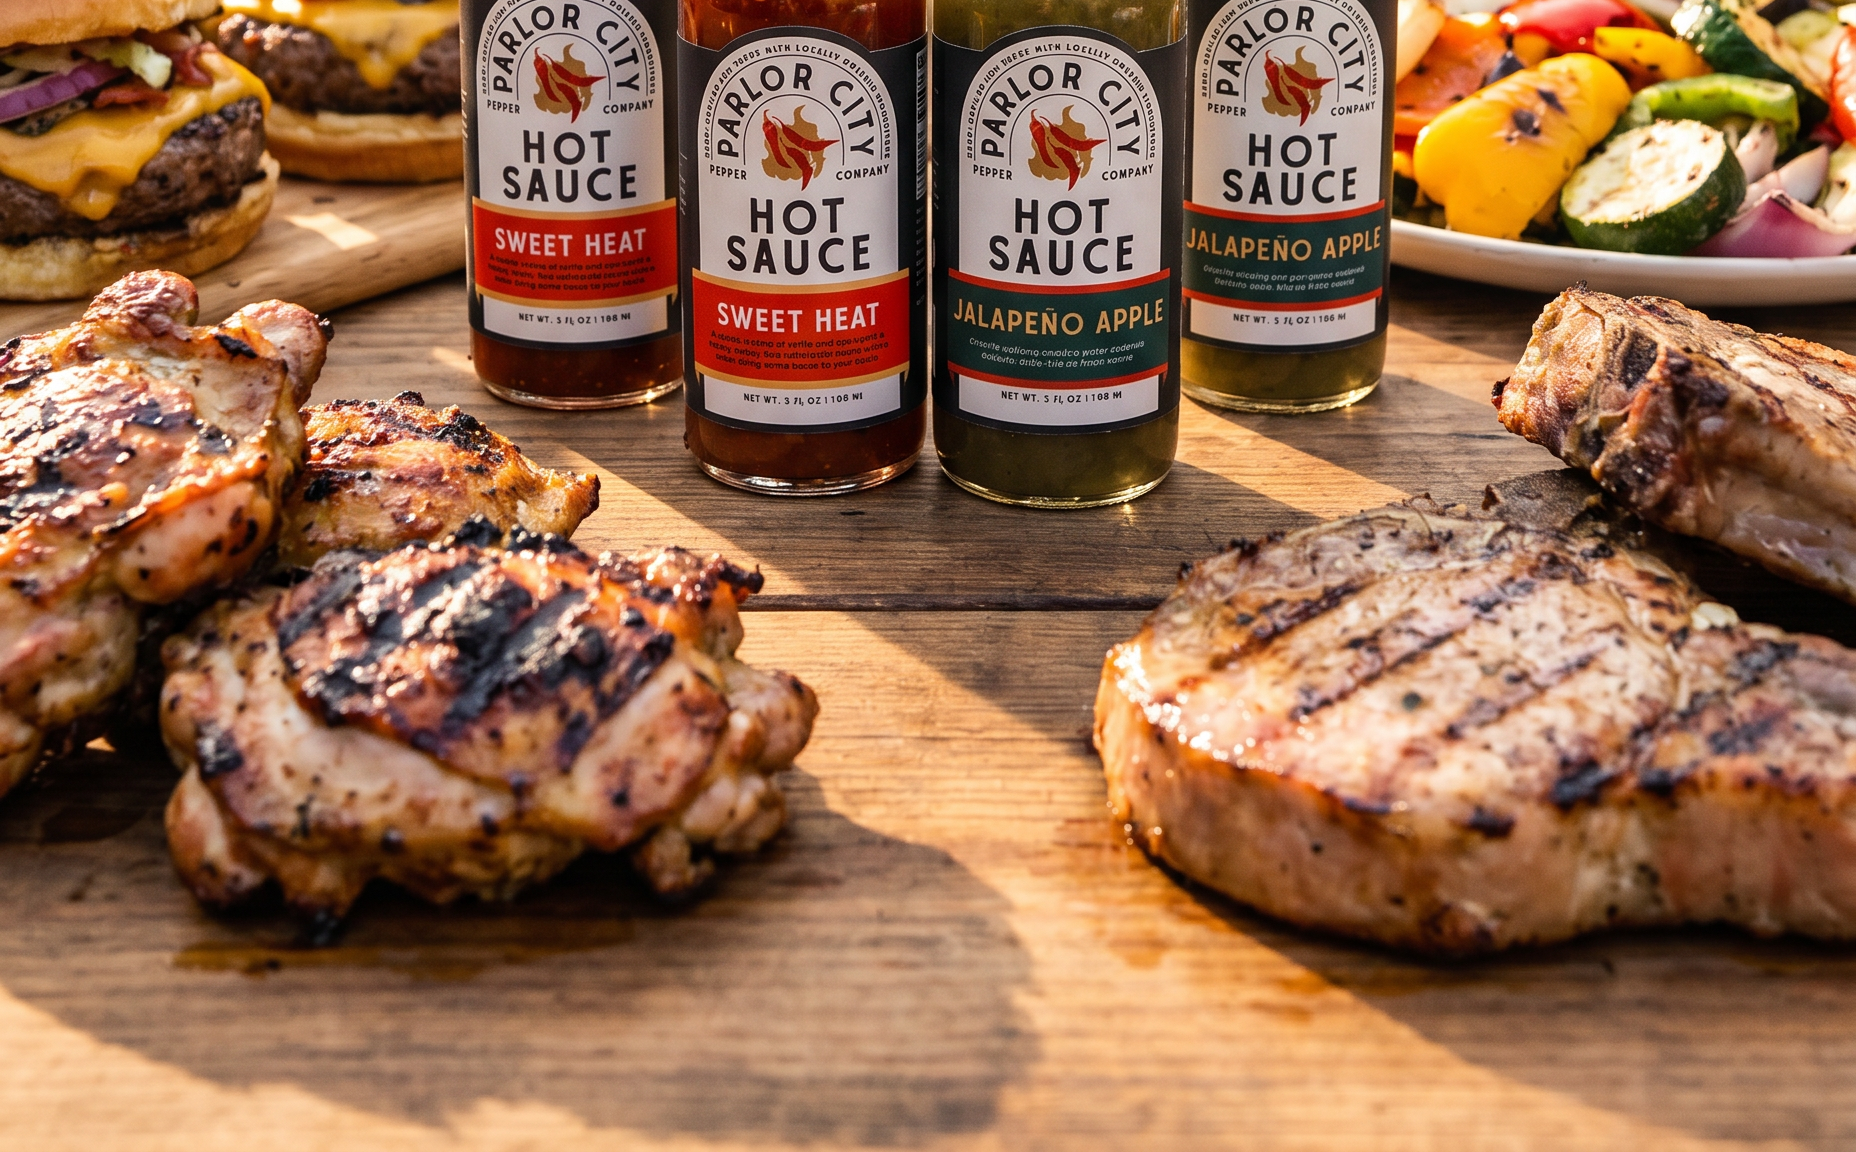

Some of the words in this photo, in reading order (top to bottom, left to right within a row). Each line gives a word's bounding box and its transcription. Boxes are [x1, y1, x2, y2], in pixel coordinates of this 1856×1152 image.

[493, 4, 580, 93] PARLOR
[596, 21, 640, 92] CITY
[1216, 5, 1315, 97] PARLOR
[1328, 22, 1365, 93] CITY
[487, 99, 520, 114] PEPPER
[717, 63, 812, 158] PARLOR
[829, 80, 875, 156] CITY
[981, 62, 1082, 158] PARLOR
[1098, 80, 1140, 155] CITY
[1207, 103, 1247, 118] PEPPER
[523, 130, 611, 165] HOT
[1248, 132, 1337, 168] HOT
[502, 164, 637, 203] SAUCE
[710, 164, 747, 181] PEPPER
[973, 164, 1013, 181] PEPPER
[1222, 166, 1357, 206] SAUCE
[750, 197, 845, 236] HOT
[1014, 198, 1110, 236] HOT
[495, 227, 573, 257] SWEET
[585, 228, 646, 256] HEAT
[727, 234, 870, 276] SAUCE
[988, 234, 1134, 276] SAUCE
[1186, 228, 1312, 262] JALAPEÑO
[1321, 225, 1382, 260] APPLE
[519, 313, 534, 322] NET
[577, 316, 591, 324] OZ
[717, 302, 803, 334] SWEET
[815, 301, 880, 333] HEAT
[953, 298, 1084, 336] JALAPEÑO
[1095, 298, 1164, 335] APPLE
[1233, 313, 1250, 323] NET
[1296, 316, 1310, 325] OZ
[743, 393, 761, 403] NET
[763, 395, 781, 405] WT.
[807, 397, 821, 405] OZ
[1001, 391, 1019, 400] NET
[1022, 393, 1040, 403] WT.
[1067, 395, 1082, 403] OZ
